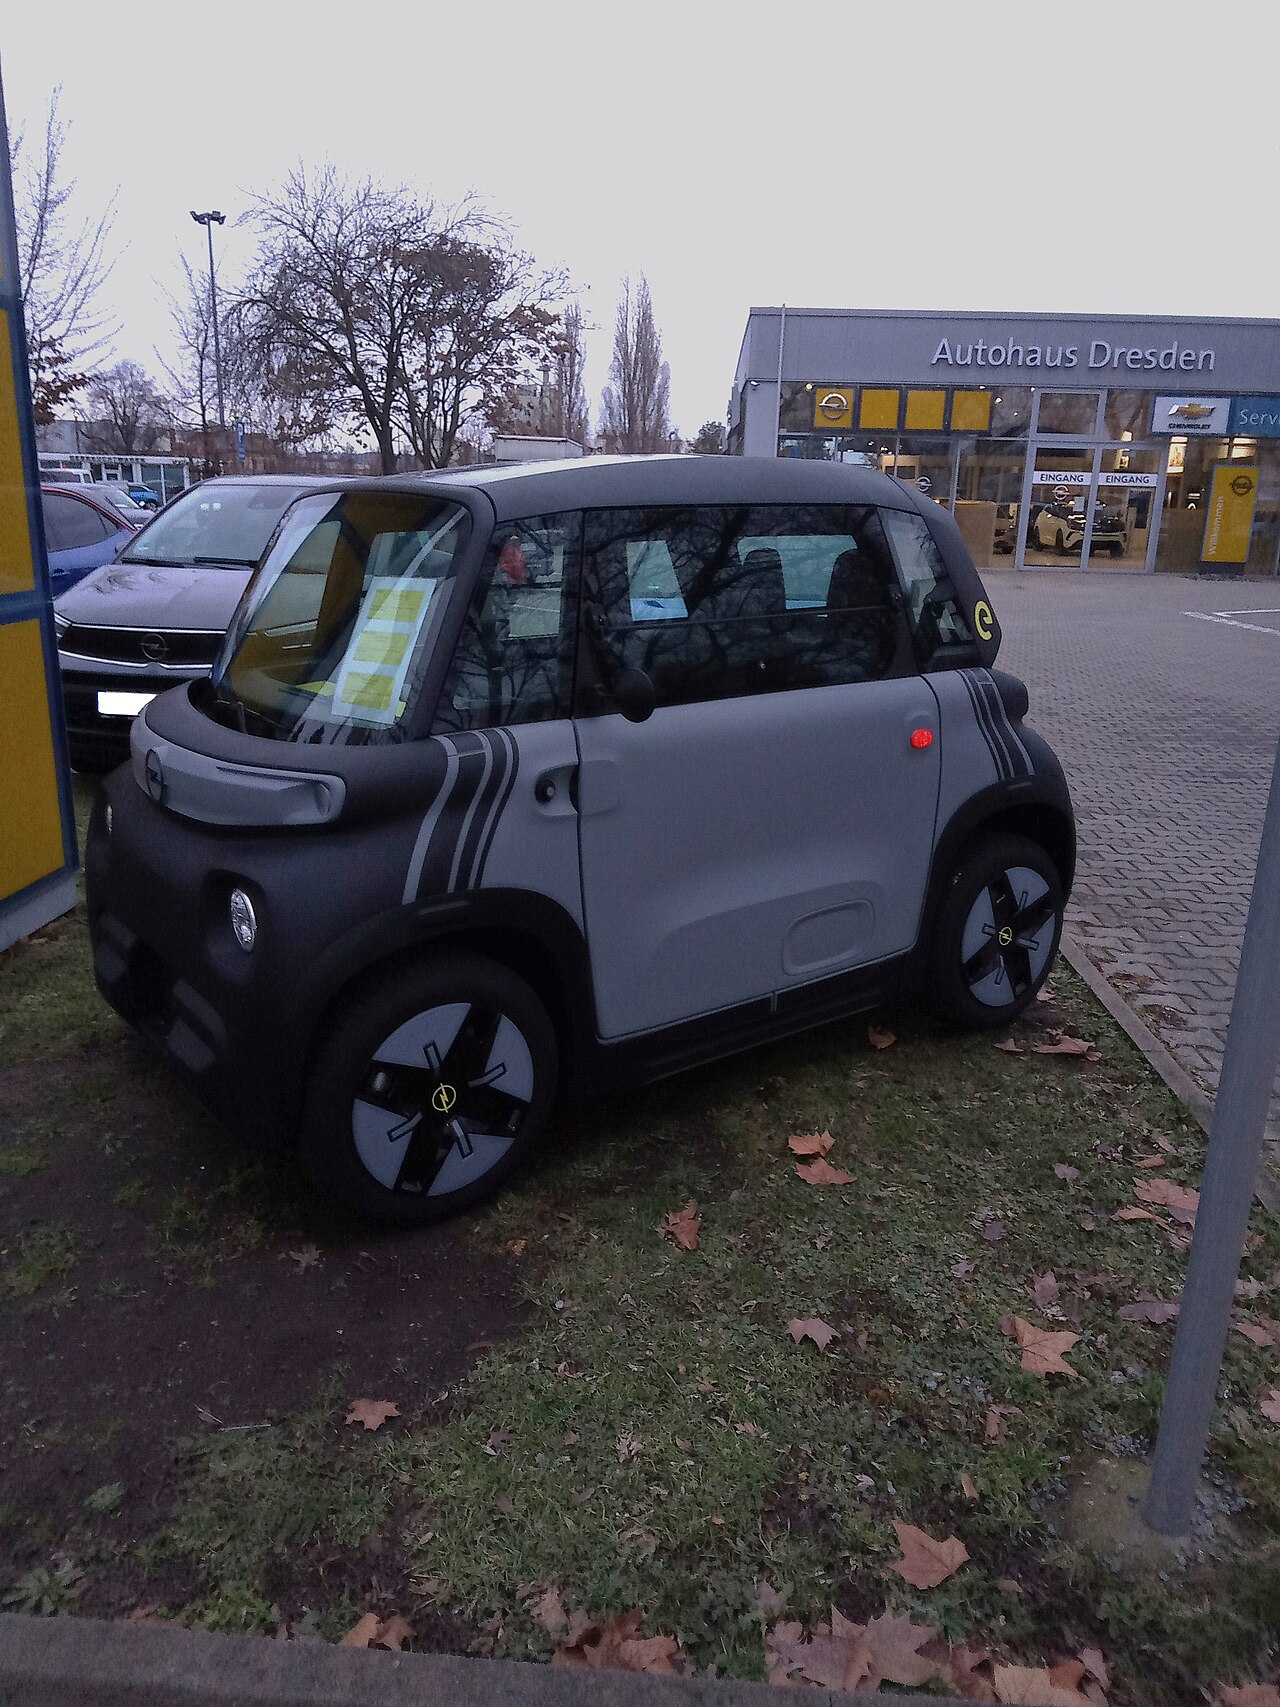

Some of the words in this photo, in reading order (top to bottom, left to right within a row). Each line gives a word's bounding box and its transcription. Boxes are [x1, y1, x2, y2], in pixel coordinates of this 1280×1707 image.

[931, 336, 1078, 368] Autohaus
[1088, 341, 1216, 370] Dresden
[1040, 473, 1084, 483] EINGANG
[1105, 475, 1150, 484] EINGANG
[1208, 495, 1225, 556] Willkommen
